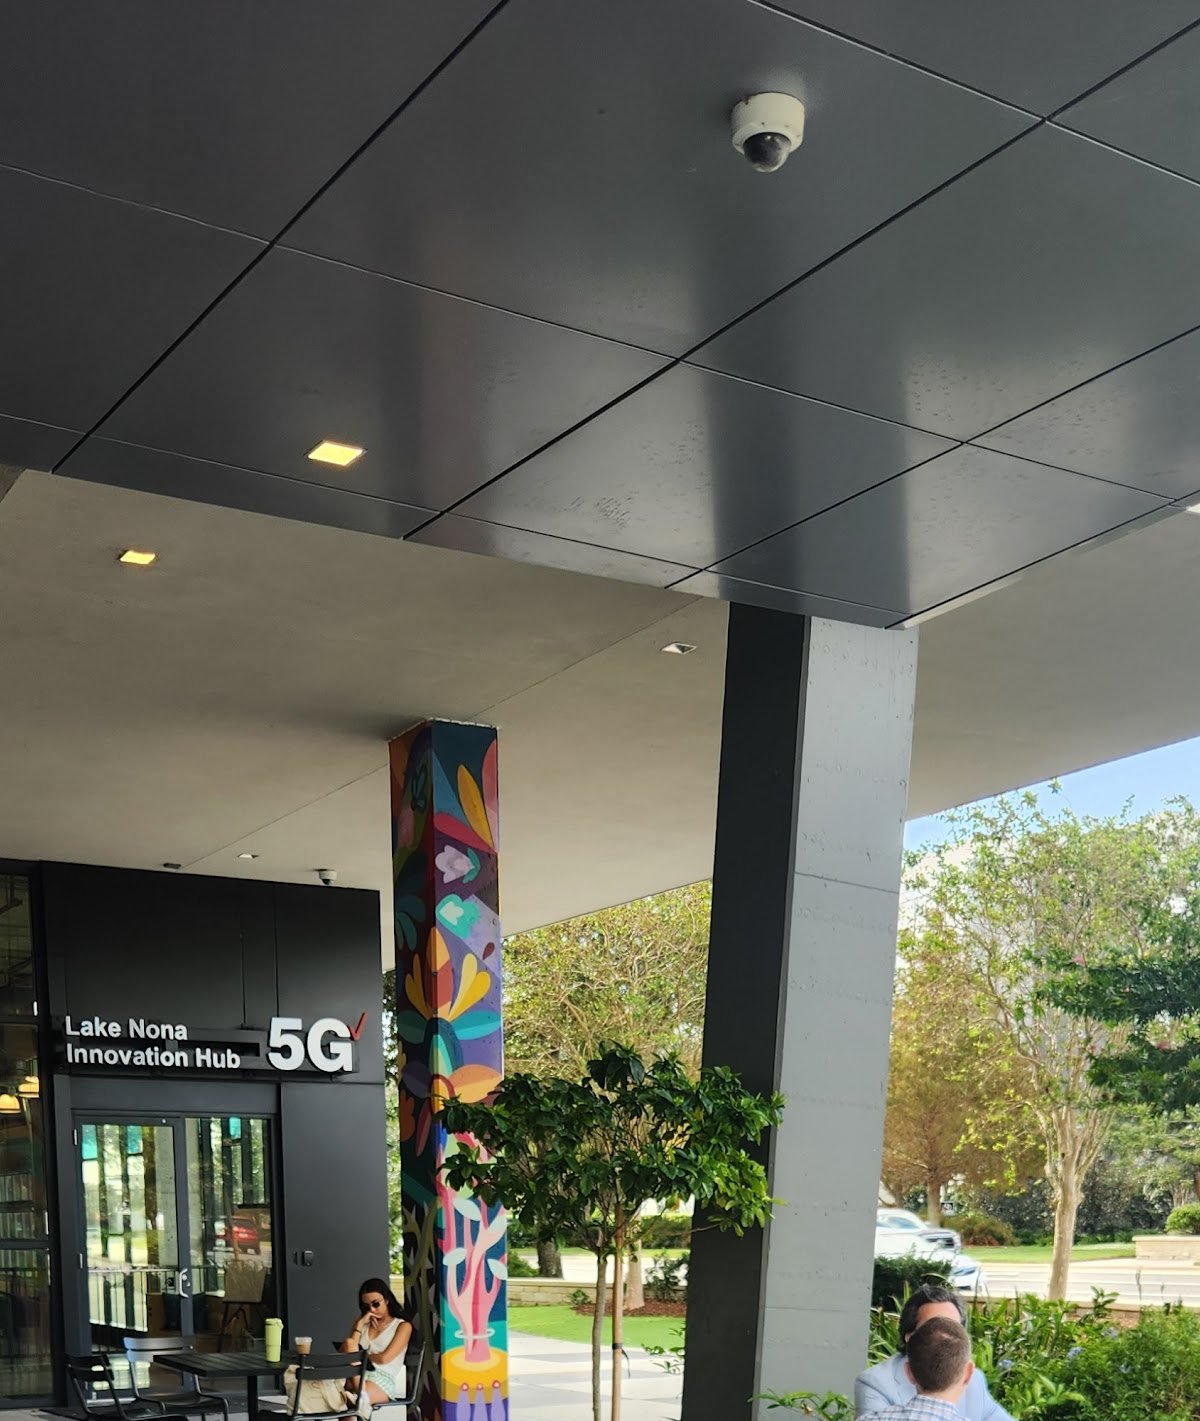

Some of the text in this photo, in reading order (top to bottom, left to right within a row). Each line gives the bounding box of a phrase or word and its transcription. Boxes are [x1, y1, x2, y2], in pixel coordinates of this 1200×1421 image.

[65, 1015, 188, 1041] Lake Nona
[66, 1043, 241, 1069] Innovation Hub
[267, 1016, 354, 1072] 5G
